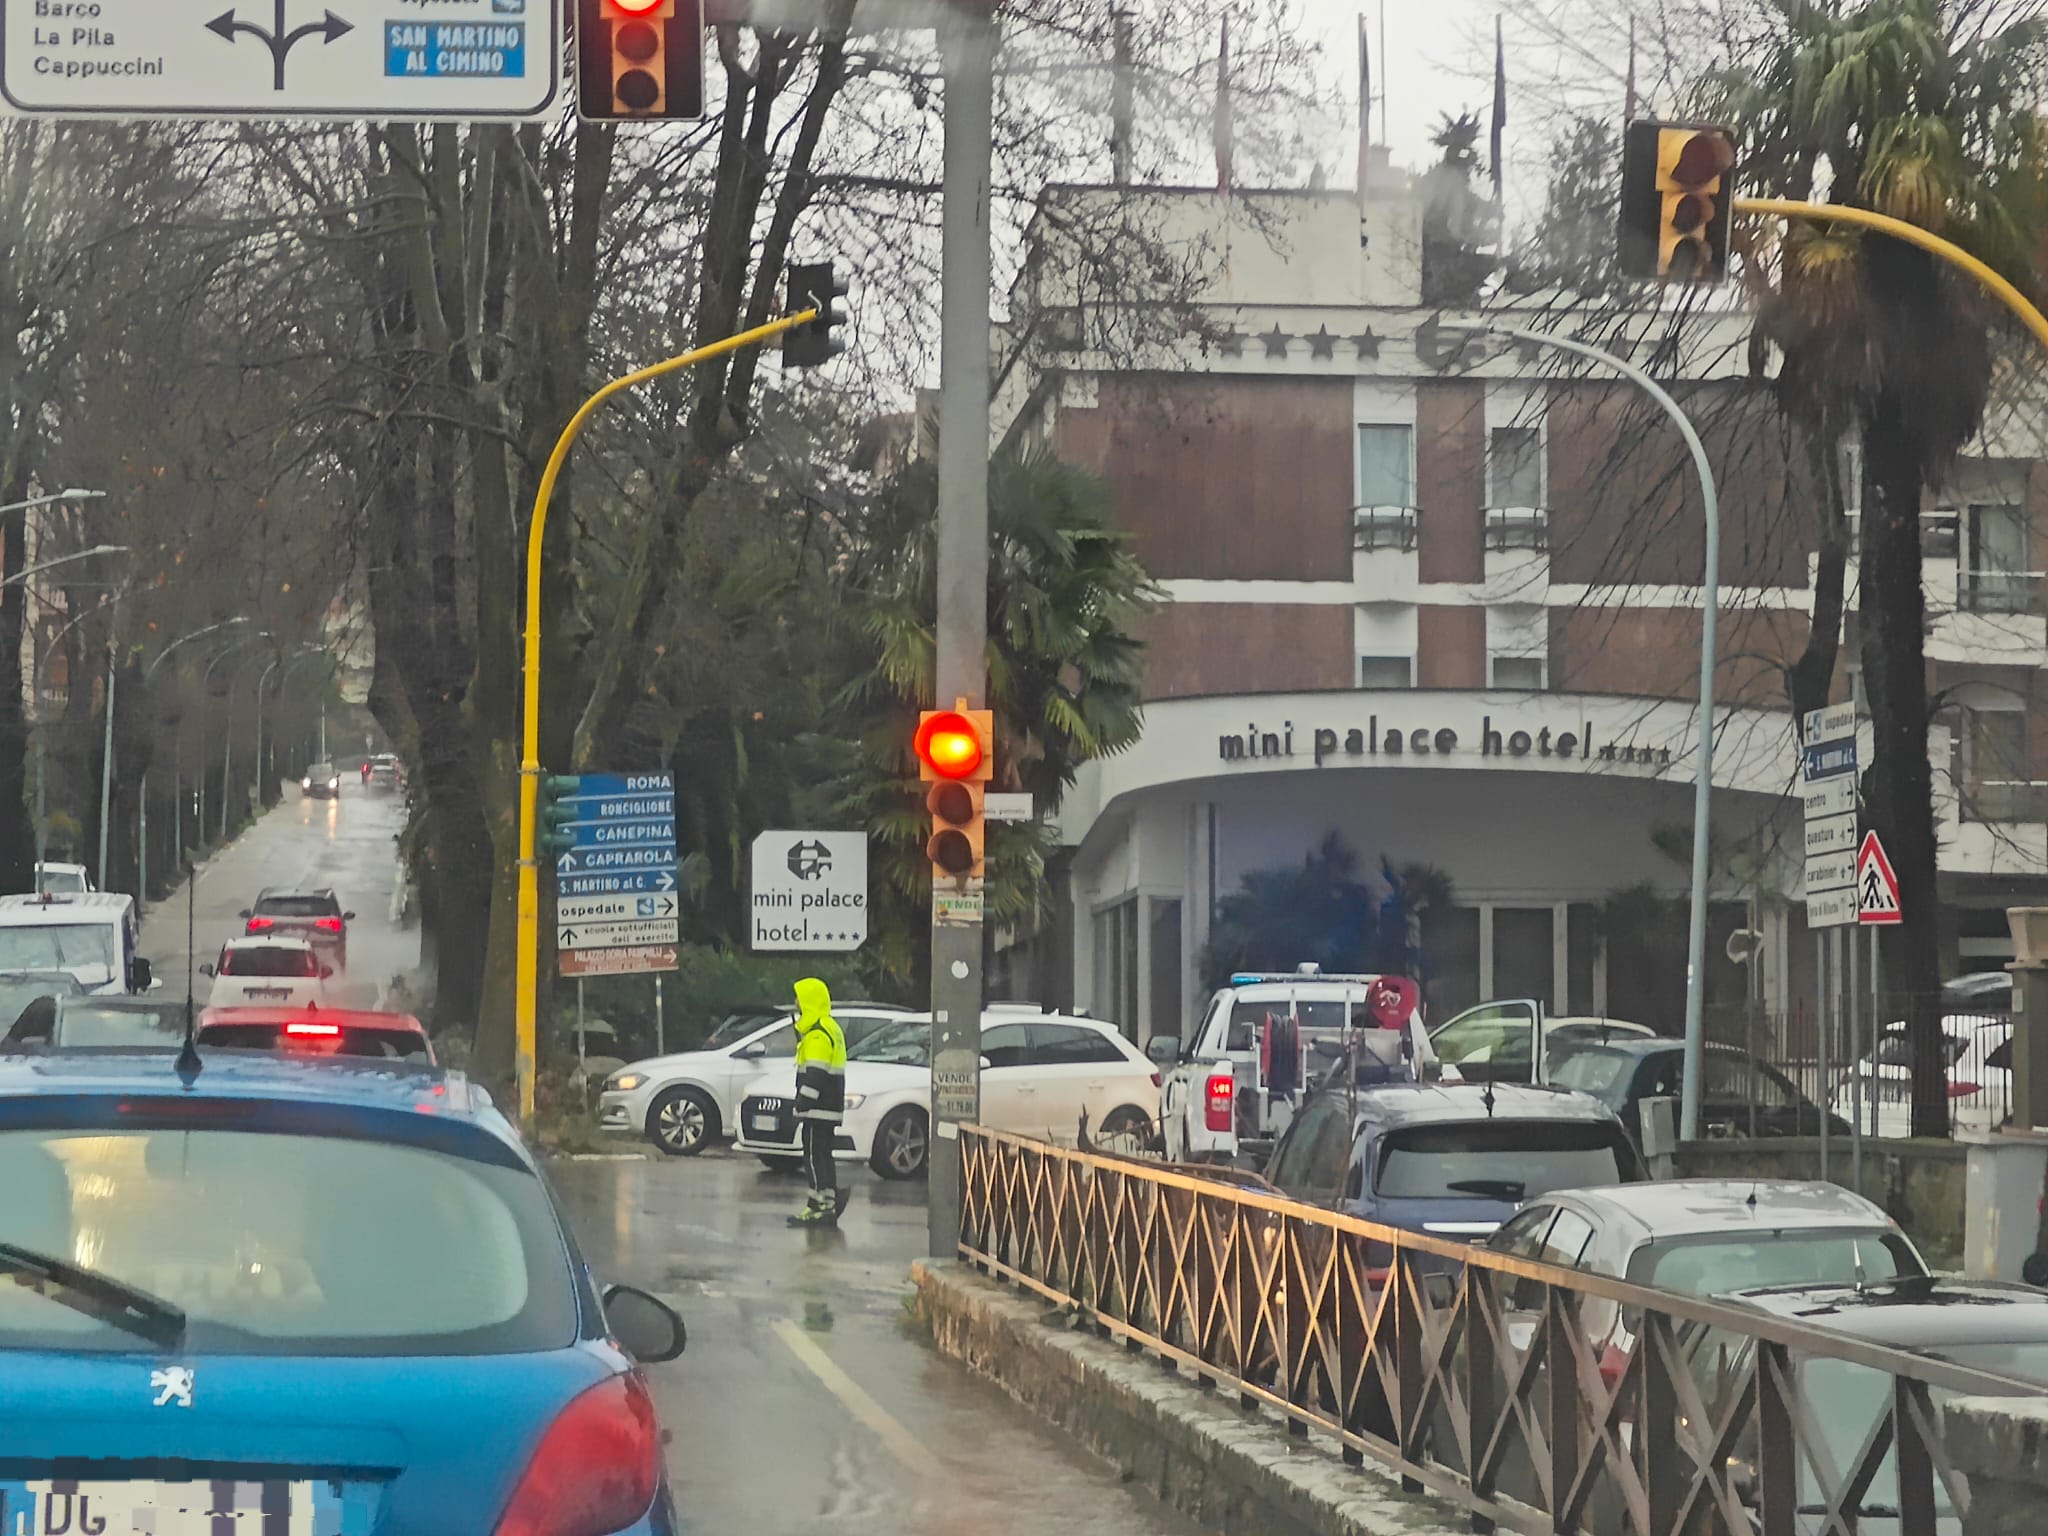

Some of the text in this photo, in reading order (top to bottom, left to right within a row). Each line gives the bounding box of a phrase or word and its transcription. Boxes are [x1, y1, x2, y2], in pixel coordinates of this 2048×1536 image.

[35, 0, 101, 17] Barco
[34, 27, 115, 46] La Pila
[391, 26, 519, 48] SAN MARTINO
[34, 55, 163, 78] Cappuccini
[406, 50, 504, 72] AL CIMINO
[1219, 715, 1592, 767] mini palace hotel
[627, 775, 671, 790] ROMA
[600, 799, 672, 817] RONCIGLIONE
[595, 823, 672, 842] CANEPINA
[585, 849, 673, 868] CAPRAROLA
[560, 880, 570, 895] S.
[573, 877, 620, 893] MARTINO
[754, 887, 864, 912] mini palace
[561, 903, 625, 918] ospedale
[757, 917, 808, 942] hotel
